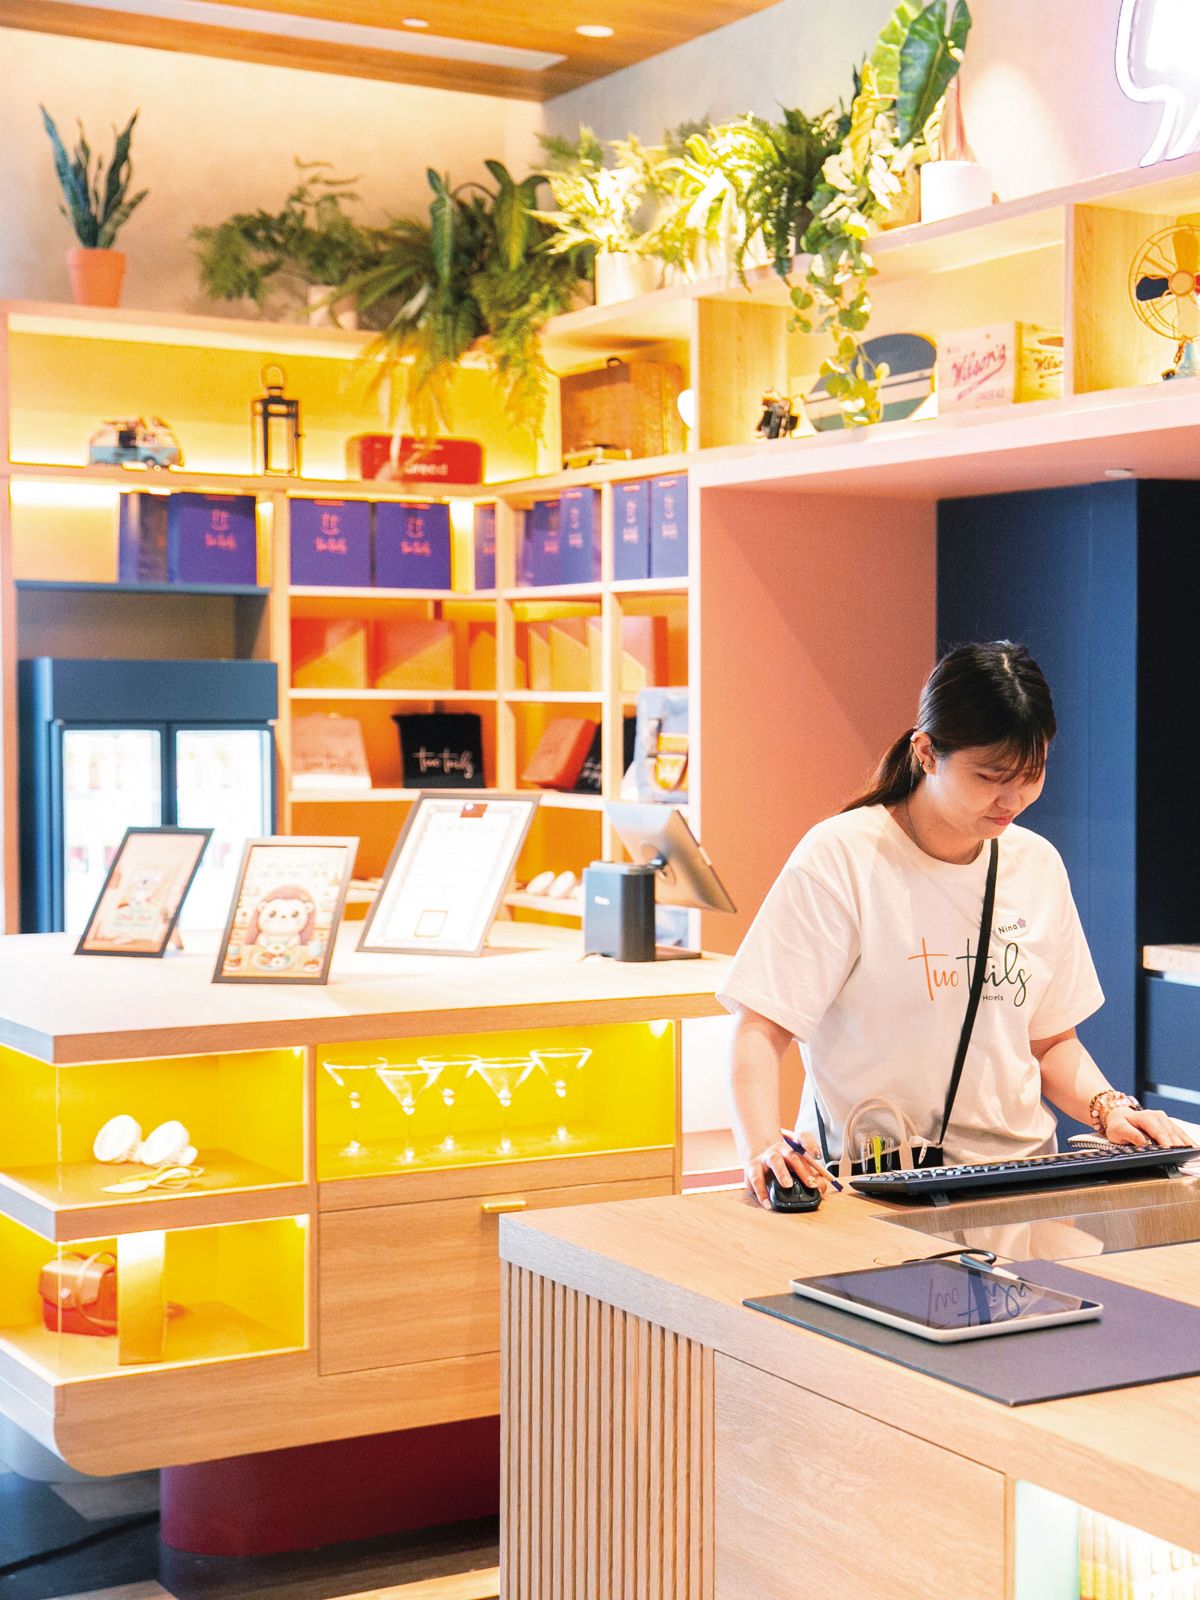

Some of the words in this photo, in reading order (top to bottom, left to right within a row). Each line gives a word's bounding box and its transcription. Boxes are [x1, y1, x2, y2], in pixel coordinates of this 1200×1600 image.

[997, 923, 1019, 935] Nina
[907, 936, 960, 1002] two
[955, 937, 1033, 1008] tils
